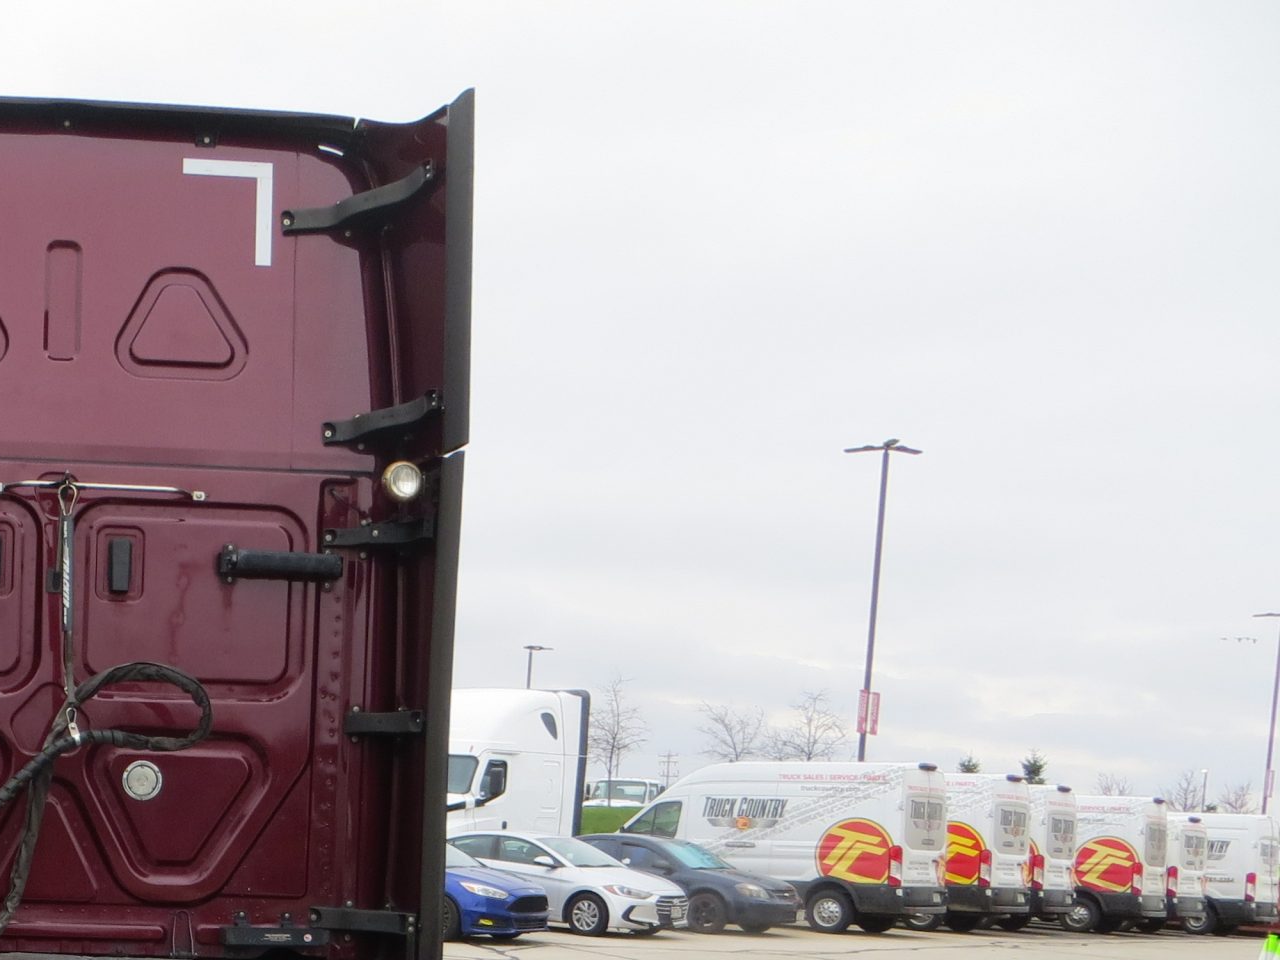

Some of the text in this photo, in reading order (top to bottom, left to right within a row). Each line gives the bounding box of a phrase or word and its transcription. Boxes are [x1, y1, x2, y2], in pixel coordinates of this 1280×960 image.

[778, 773, 802, 781] TRUCK
[803, 773, 825, 781] SALES
[702, 796, 789, 819] TRUCK COUNTRY
